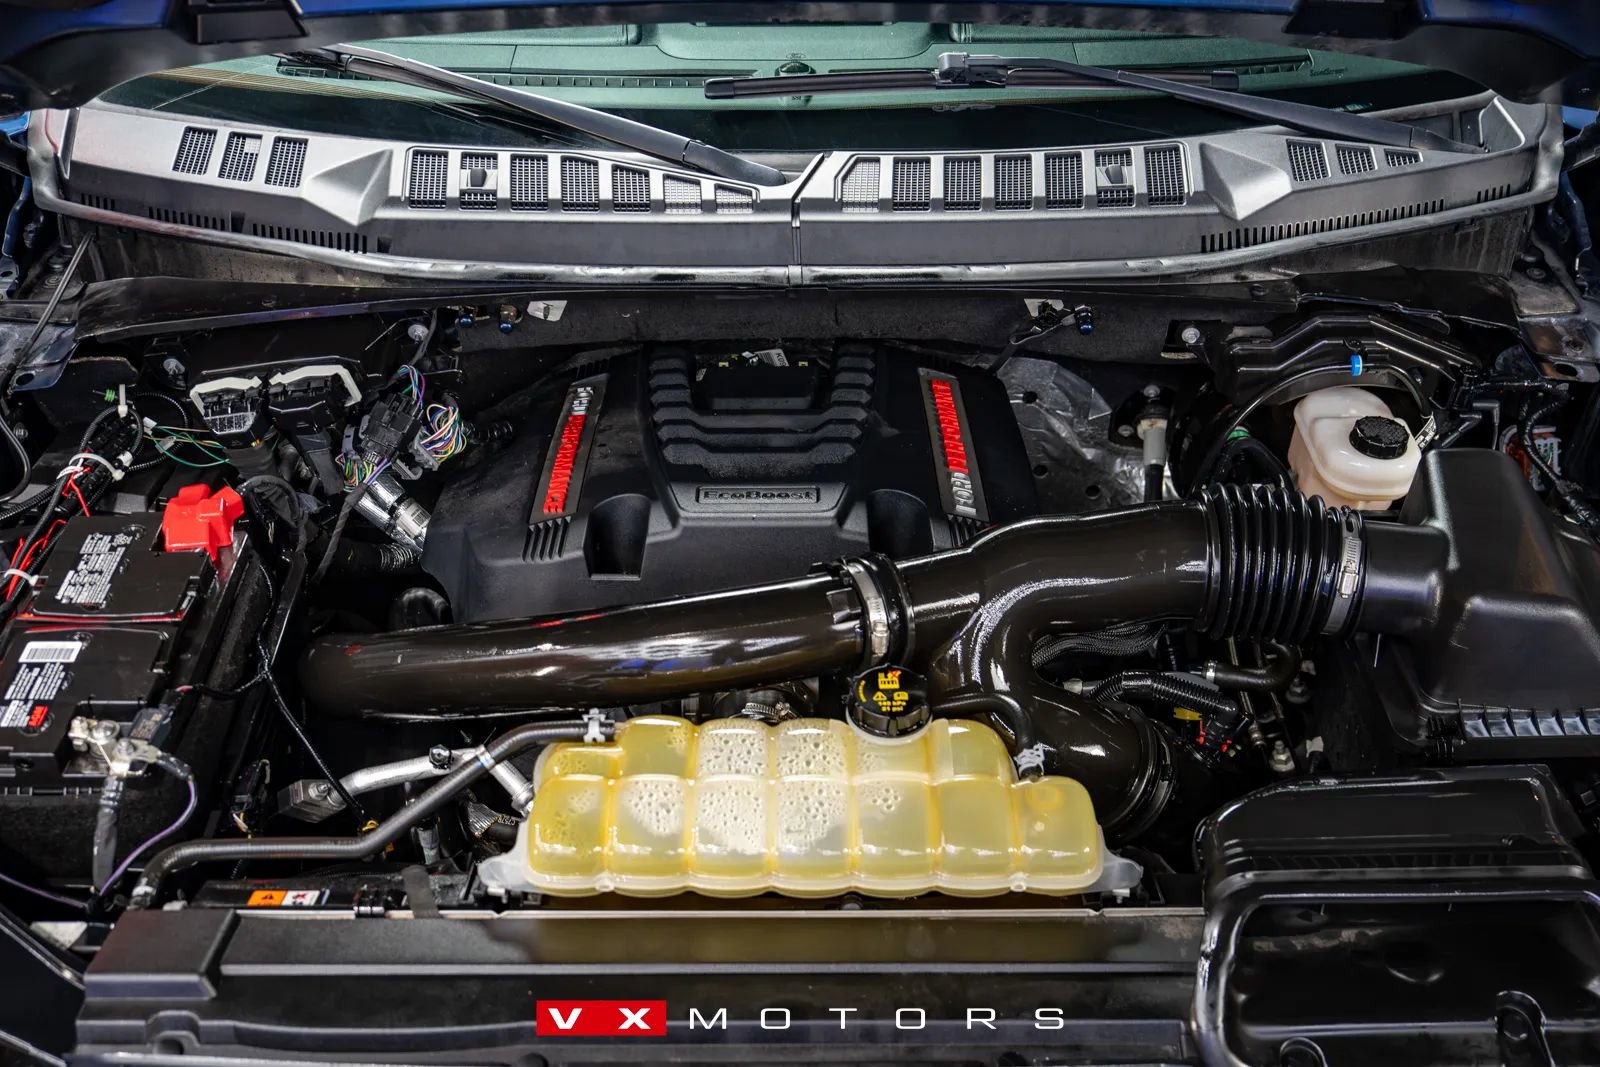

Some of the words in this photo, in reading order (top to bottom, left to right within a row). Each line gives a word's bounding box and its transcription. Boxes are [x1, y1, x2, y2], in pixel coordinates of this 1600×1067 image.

[571, 386, 594, 415] FORD
[932, 379, 969, 474] PERFORMANCE
[543, 415, 586, 513] PERFORMANCE
[703, 490, 815, 500] EcoBoost
[951, 472, 977, 516] FORD
